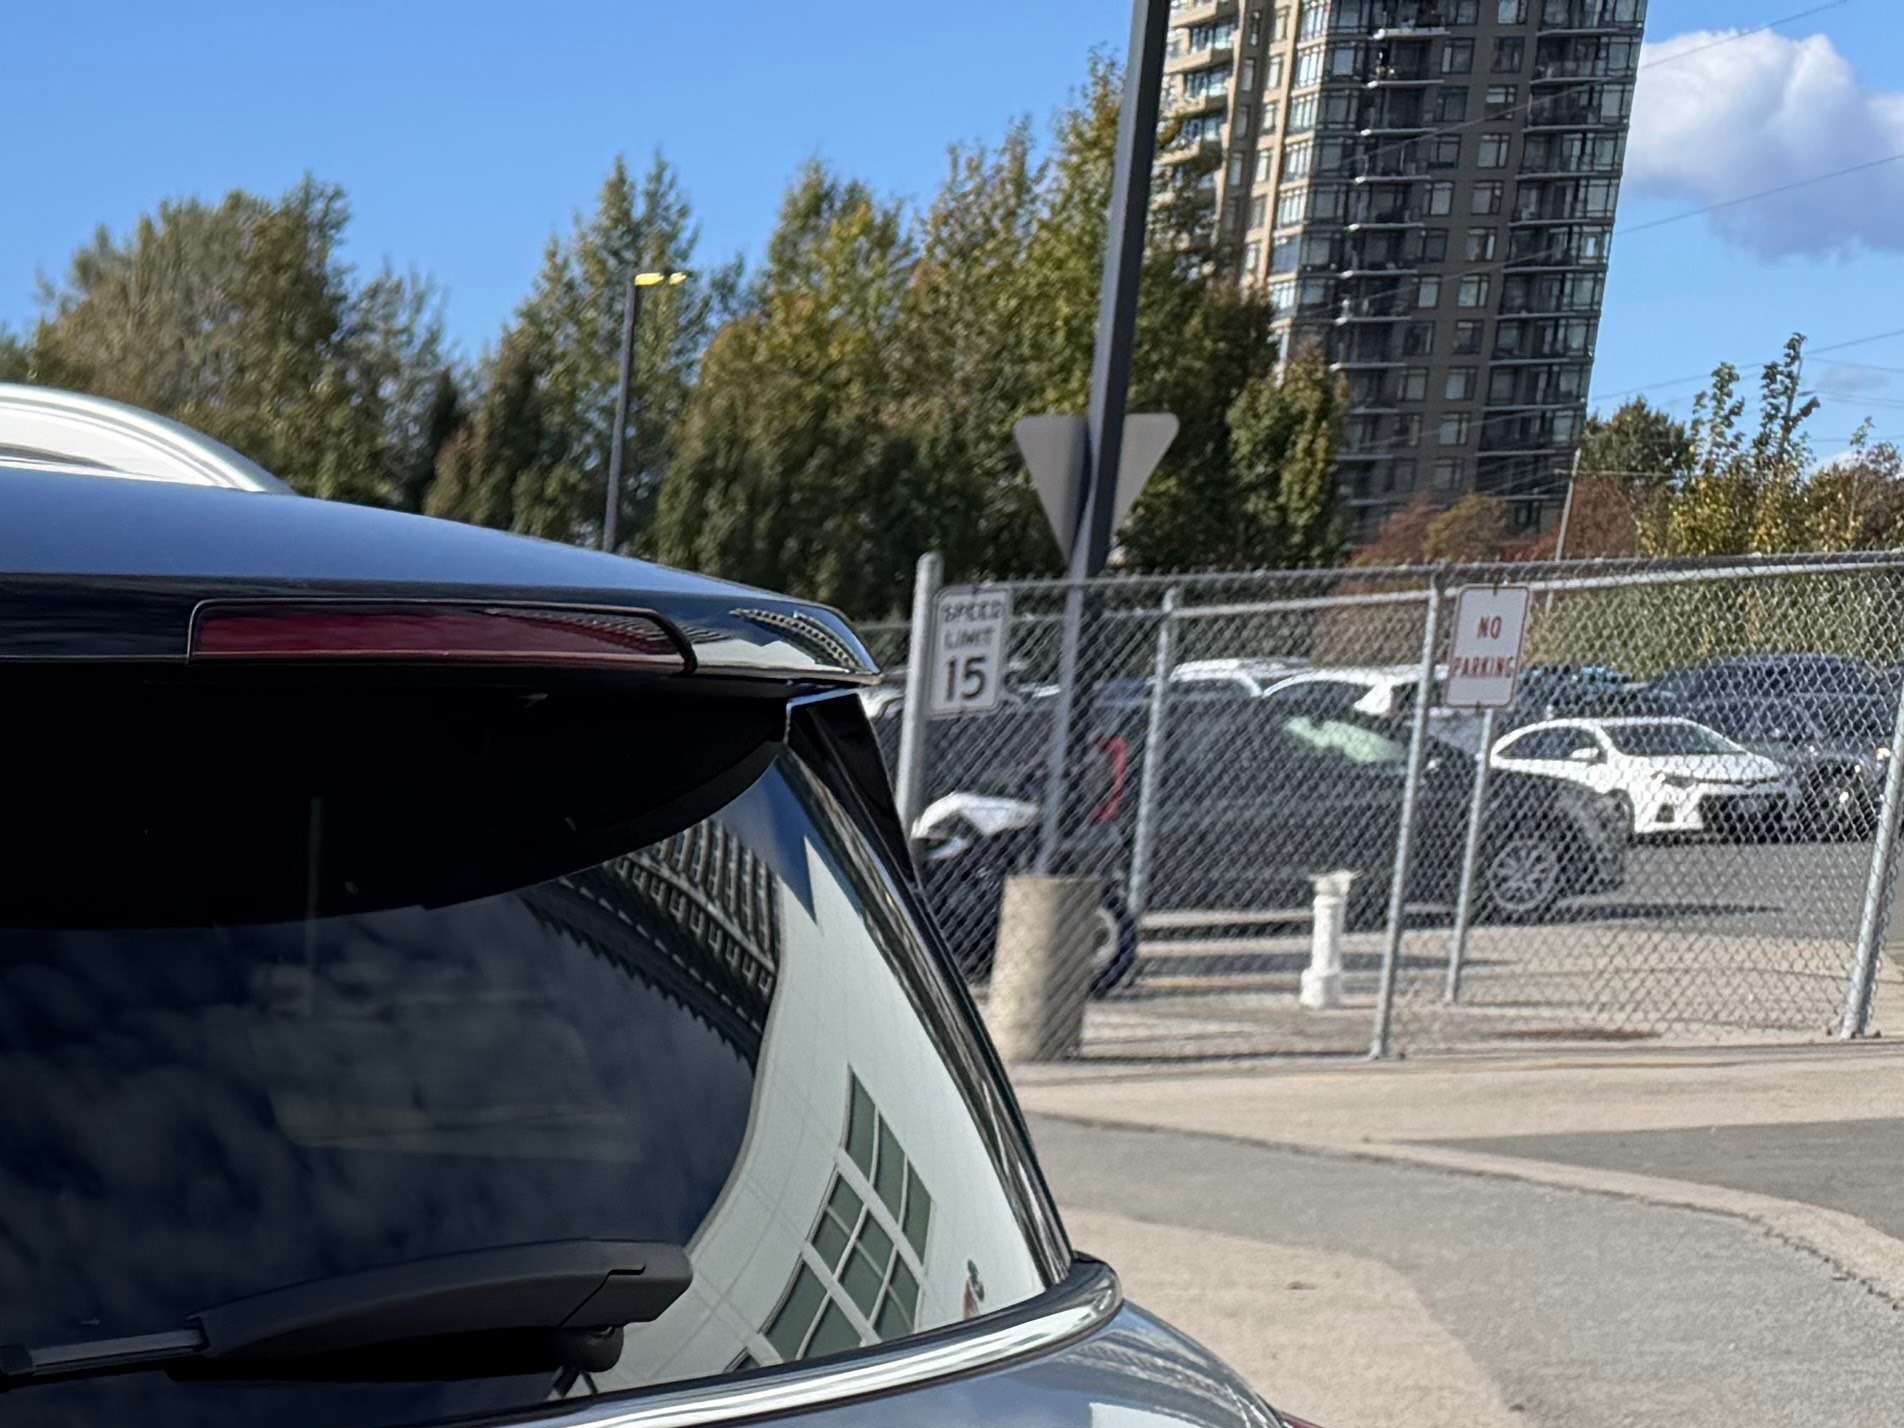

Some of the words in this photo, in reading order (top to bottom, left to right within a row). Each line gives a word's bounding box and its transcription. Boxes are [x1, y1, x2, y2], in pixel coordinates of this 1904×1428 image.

[943, 600, 1003, 621] SPEED
[943, 626, 995, 649] LIMIT
[1477, 616, 1502, 640] NO
[945, 655, 986, 701] 15
[1452, 656, 1515, 678] PARKING
